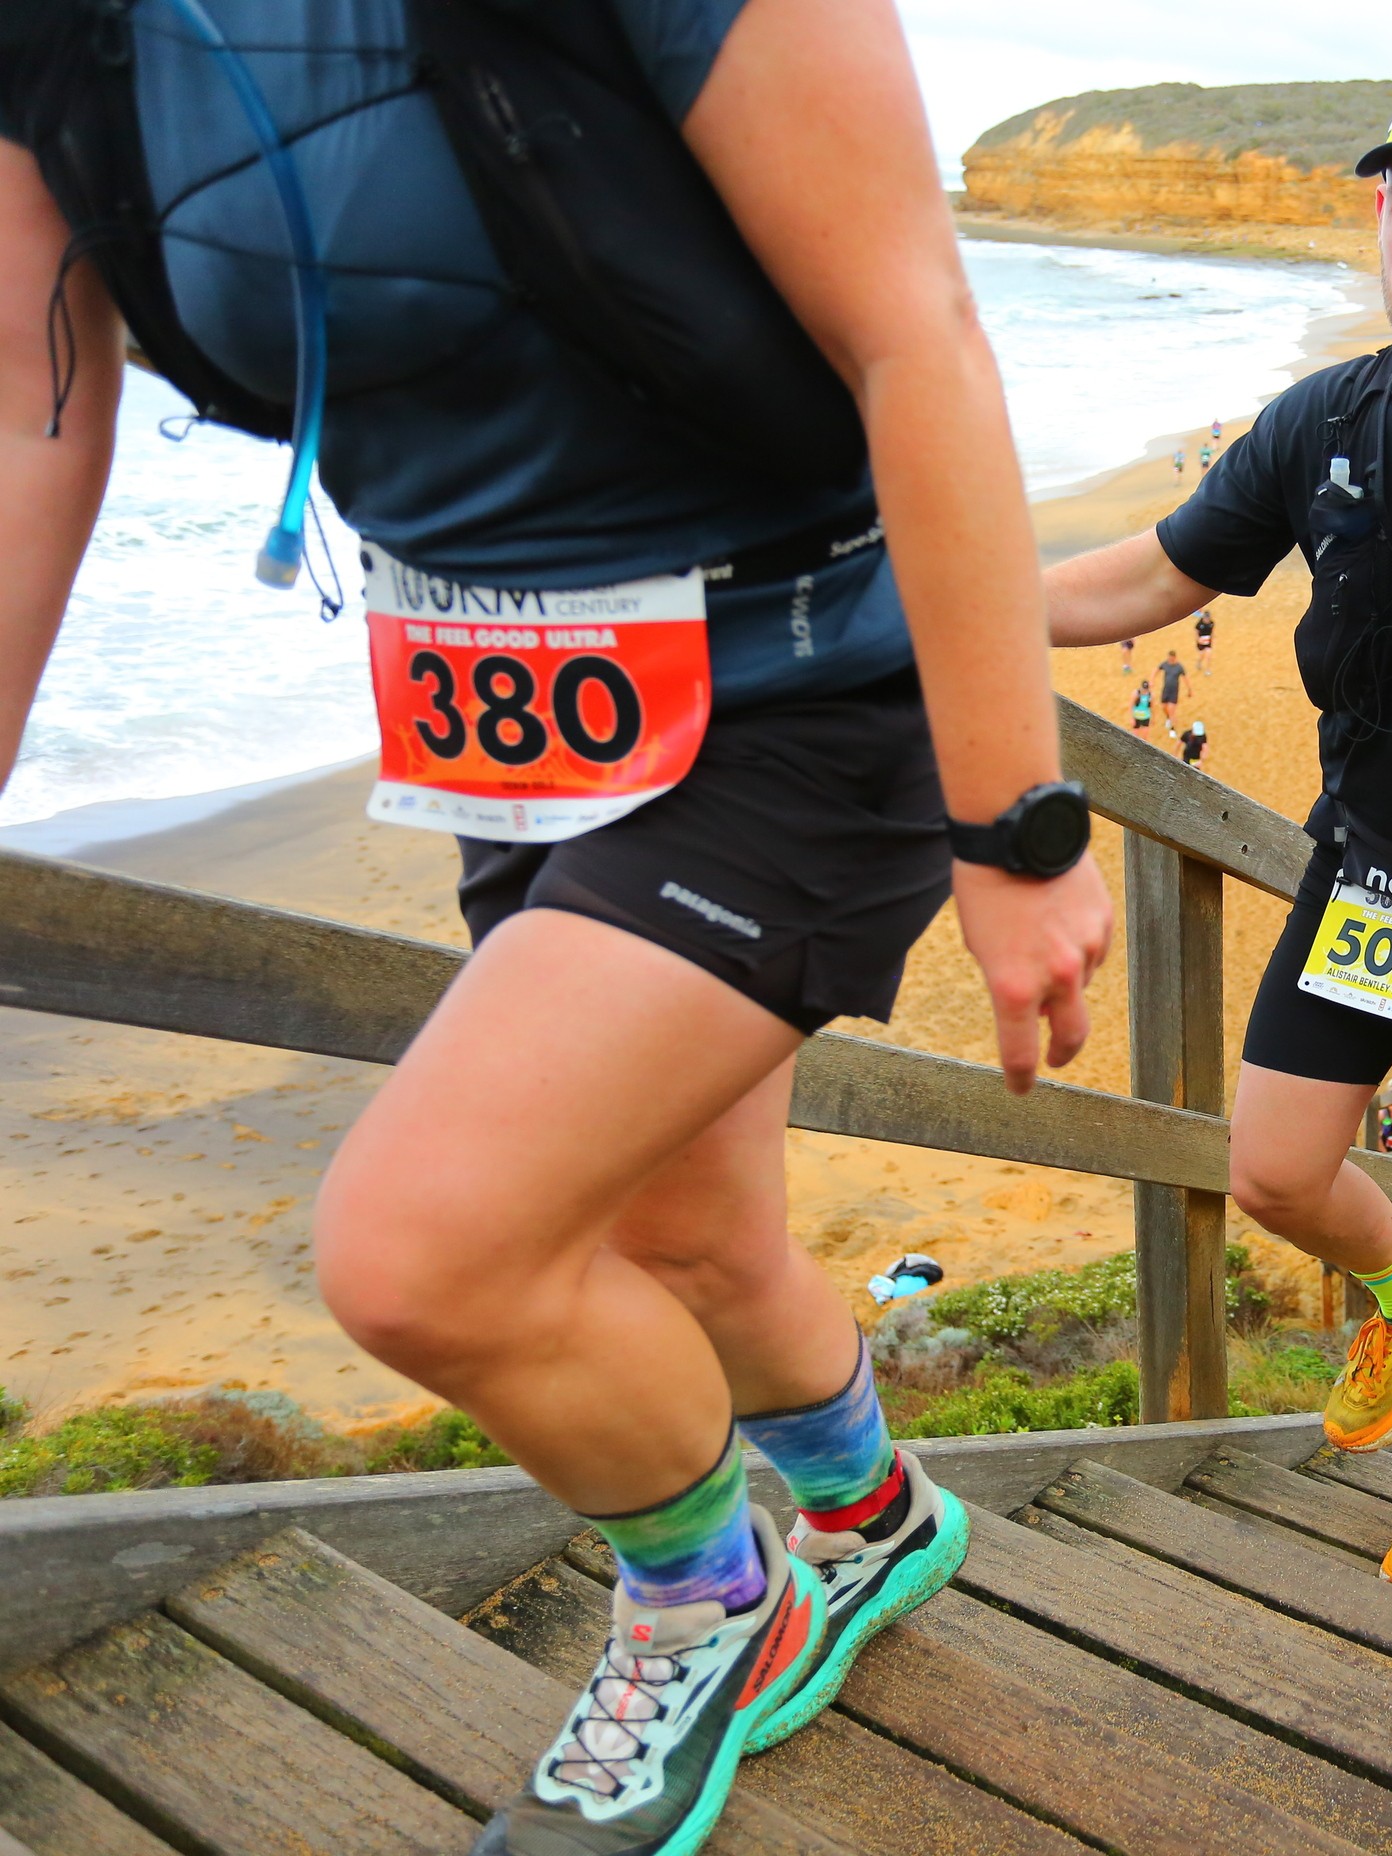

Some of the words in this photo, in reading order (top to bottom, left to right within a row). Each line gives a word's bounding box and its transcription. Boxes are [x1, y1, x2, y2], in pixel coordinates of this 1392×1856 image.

[556, 596, 642, 616] CENTURY
[405, 625, 433, 643] THE
[435, 626, 473, 647] FEEL
[475, 627, 540, 649] GOOD
[546, 628, 618, 649] ULTRA
[410, 650, 643, 766] 380
[660, 881, 762, 939] patagonia
[1361, 909, 1378, 921] THE
[1326, 967, 1358, 984] ALISTAIR
[1359, 976, 1391, 993] BENTLEY
[753, 1599, 794, 1694] SALOMON
